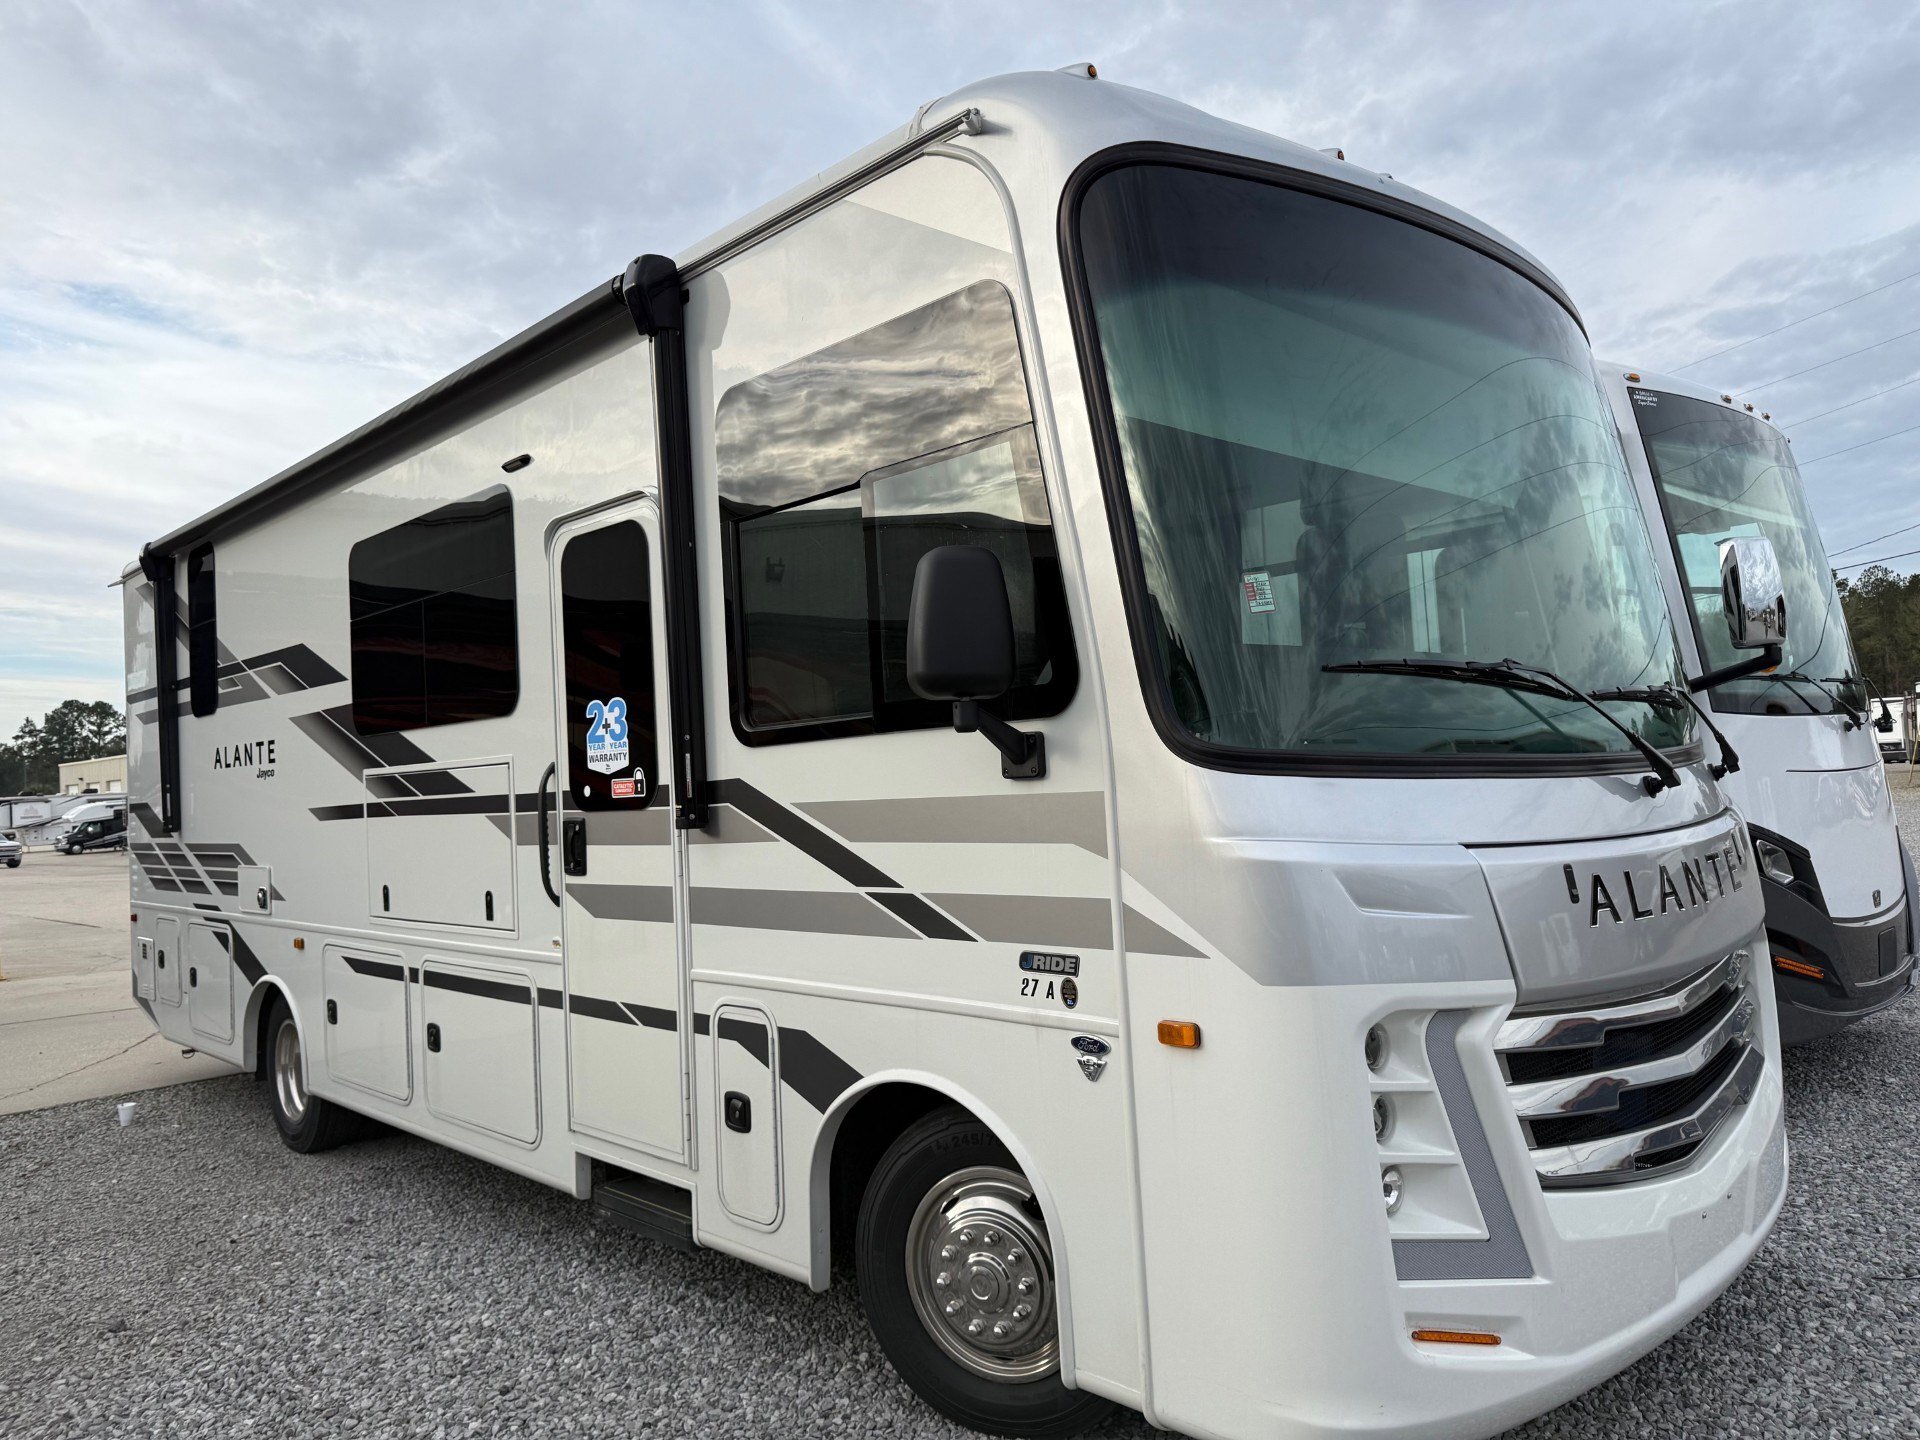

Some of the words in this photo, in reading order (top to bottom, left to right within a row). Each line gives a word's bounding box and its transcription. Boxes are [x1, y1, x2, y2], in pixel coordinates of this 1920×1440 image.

[214, 739, 276, 769] ALANTE
[588, 753, 627, 763] WARRANTY
[256, 768, 275, 780] Jayco
[1590, 846, 1744, 928] ALANTE
[1020, 977, 1039, 997] 27
[1046, 980, 1055, 1000] A
[1077, 1038, 1100, 1052] Ford
